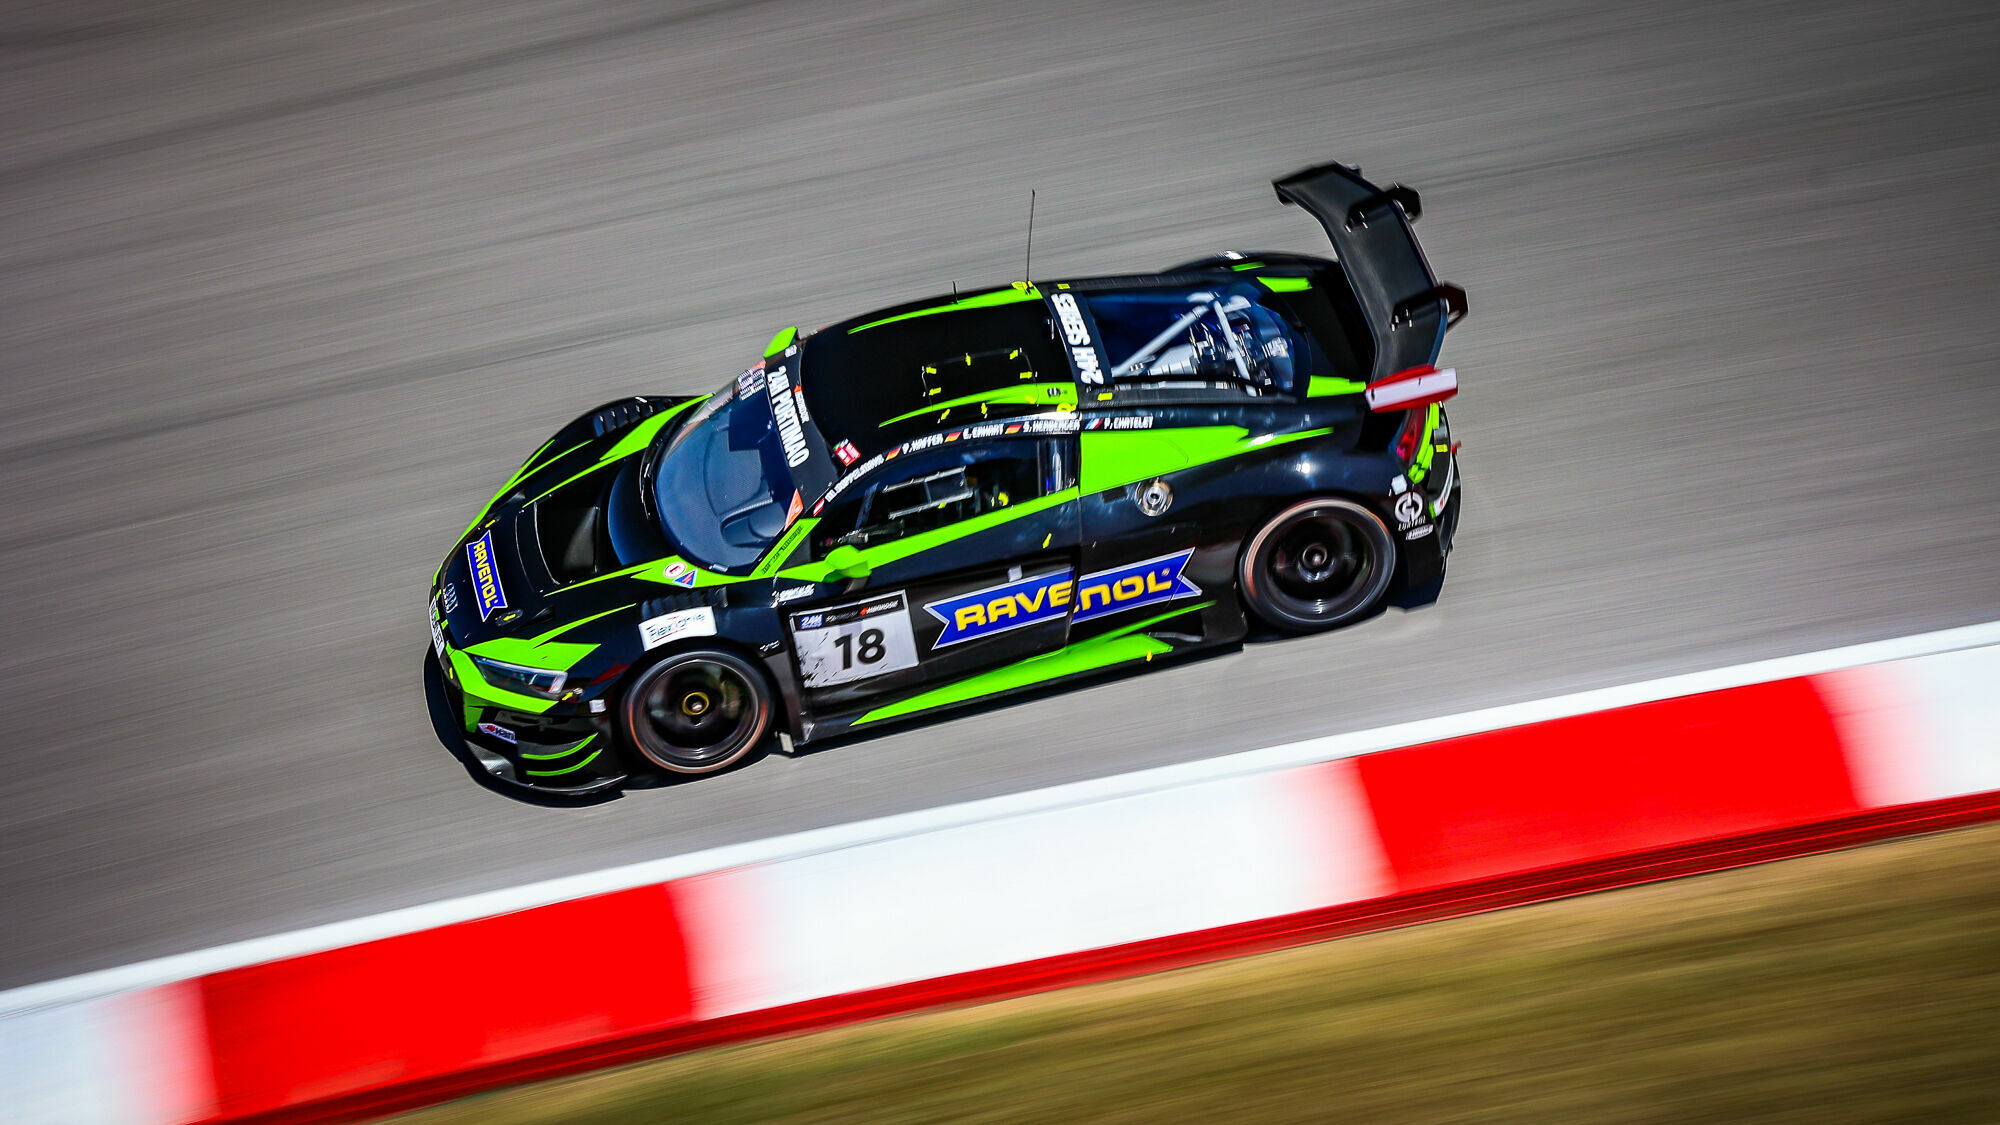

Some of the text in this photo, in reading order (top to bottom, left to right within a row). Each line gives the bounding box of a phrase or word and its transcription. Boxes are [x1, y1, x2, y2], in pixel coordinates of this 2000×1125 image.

[766, 365, 790, 398] 24H
[473, 540, 498, 608] RAVENOL
[954, 570, 1173, 631] RAVENOL
[834, 628, 886, 671] 18
